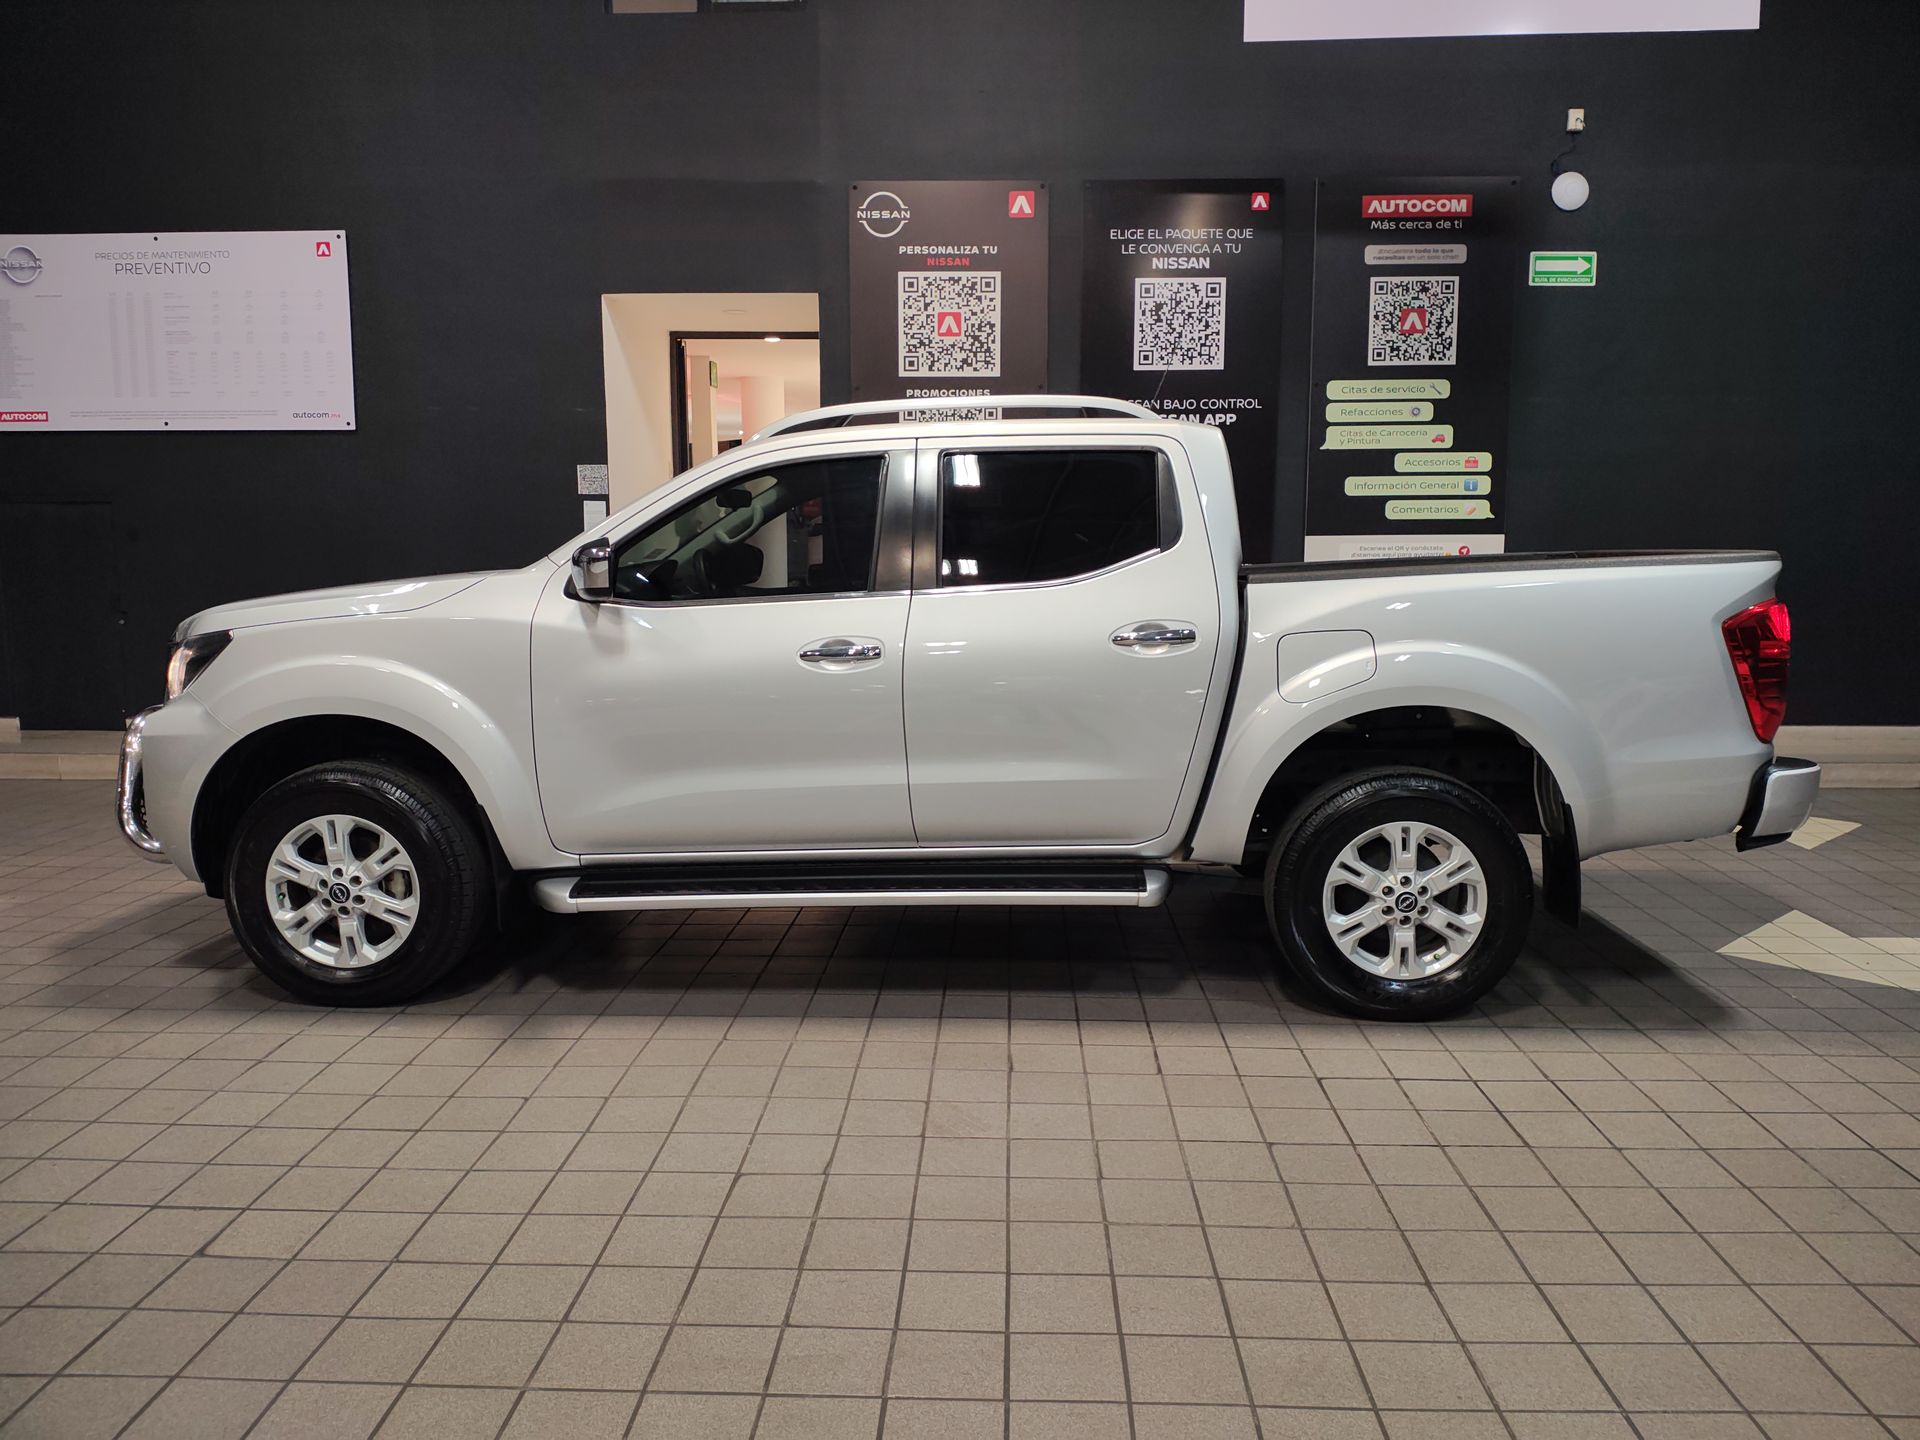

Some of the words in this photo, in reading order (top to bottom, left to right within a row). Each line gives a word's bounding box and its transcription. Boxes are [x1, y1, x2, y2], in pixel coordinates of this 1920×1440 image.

[1368, 198, 1467, 213] AUTOCOM
[856, 210, 911, 219] NISSAN
[1370, 219, 1396, 230] Más
[1399, 221, 1432, 229] cerca
[1436, 219, 1451, 229] de
[1454, 219, 1463, 229] ti
[1110, 229, 1144, 240] ELIGE
[1147, 229, 1162, 239] EL
[1166, 228, 1223, 240] PAQUETE
[1226, 228, 1254, 240] QUE
[898, 245, 979, 255] PERSONALIZA
[982, 245, 998, 254] TU
[1121, 244, 1136, 255] LE
[1139, 244, 1210, 254] CONVENGA
[1212, 243, 1222, 254] A
[1224, 243, 1242, 254] TU
[95, 251, 135, 260] PRECIOS
[136, 251, 149, 259] DE
[151, 250, 230, 259] MANTENIMIENTO
[927, 257, 970, 266] NISSAN
[1152, 257, 1210, 269] NISSAN
[114, 261, 211, 275] PREVENTIVO
[906, 388, 991, 398] PROMOCIONES
[1341, 385, 1368, 394] Citas
[1370, 386, 1383, 394] de
[1386, 385, 1426, 393] servicio
[1163, 399, 1197, 410] BAJO
[1200, 398, 1262, 409] CONTROL
[1, 413, 47, 421] AUTOCOM
[1340, 407, 1404, 417] Refacciones
[1204, 413, 1237, 426] APP
[1340, 429, 1364, 437] Citas
[1365, 429, 1377, 437] de
[1339, 437, 1345, 446] y
[1347, 437, 1381, 445] Pintura
[1404, 457, 1461, 467] Accesorios
[1354, 480, 1416, 490] Información
[1419, 480, 1459, 490] General
[1391, 505, 1459, 514] Comentarios
